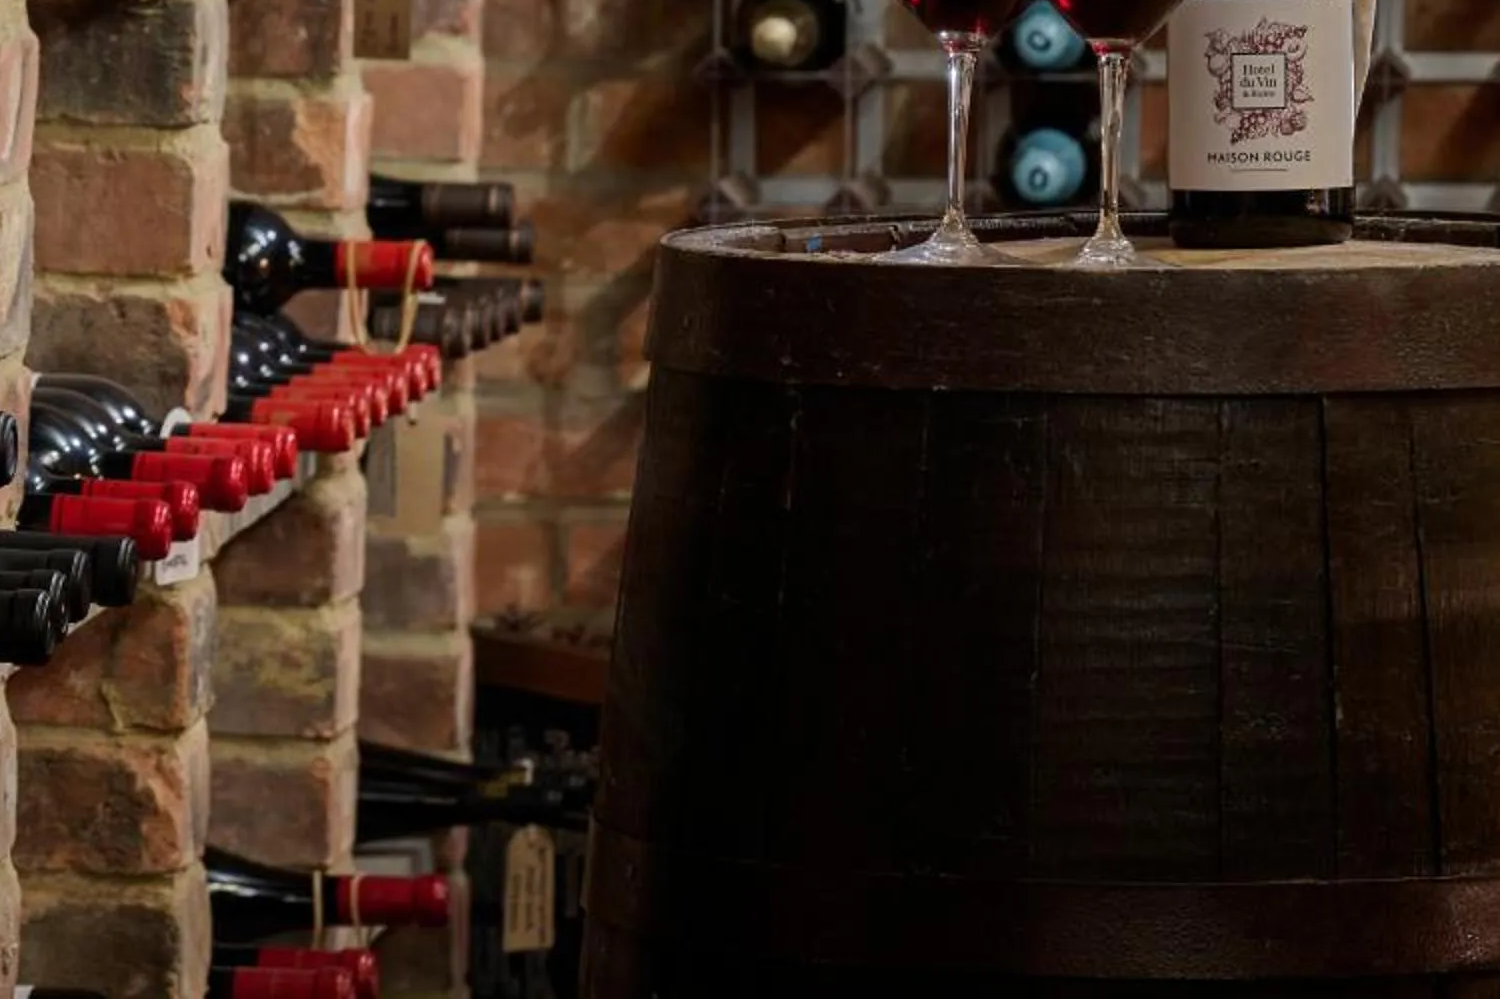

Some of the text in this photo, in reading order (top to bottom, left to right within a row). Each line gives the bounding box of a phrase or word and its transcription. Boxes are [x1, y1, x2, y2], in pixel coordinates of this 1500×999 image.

[1242, 63, 1275, 76] Hotel
[1239, 76, 1277, 88] du Vin
[1206, 150, 1312, 163] MAISON ROUGE
